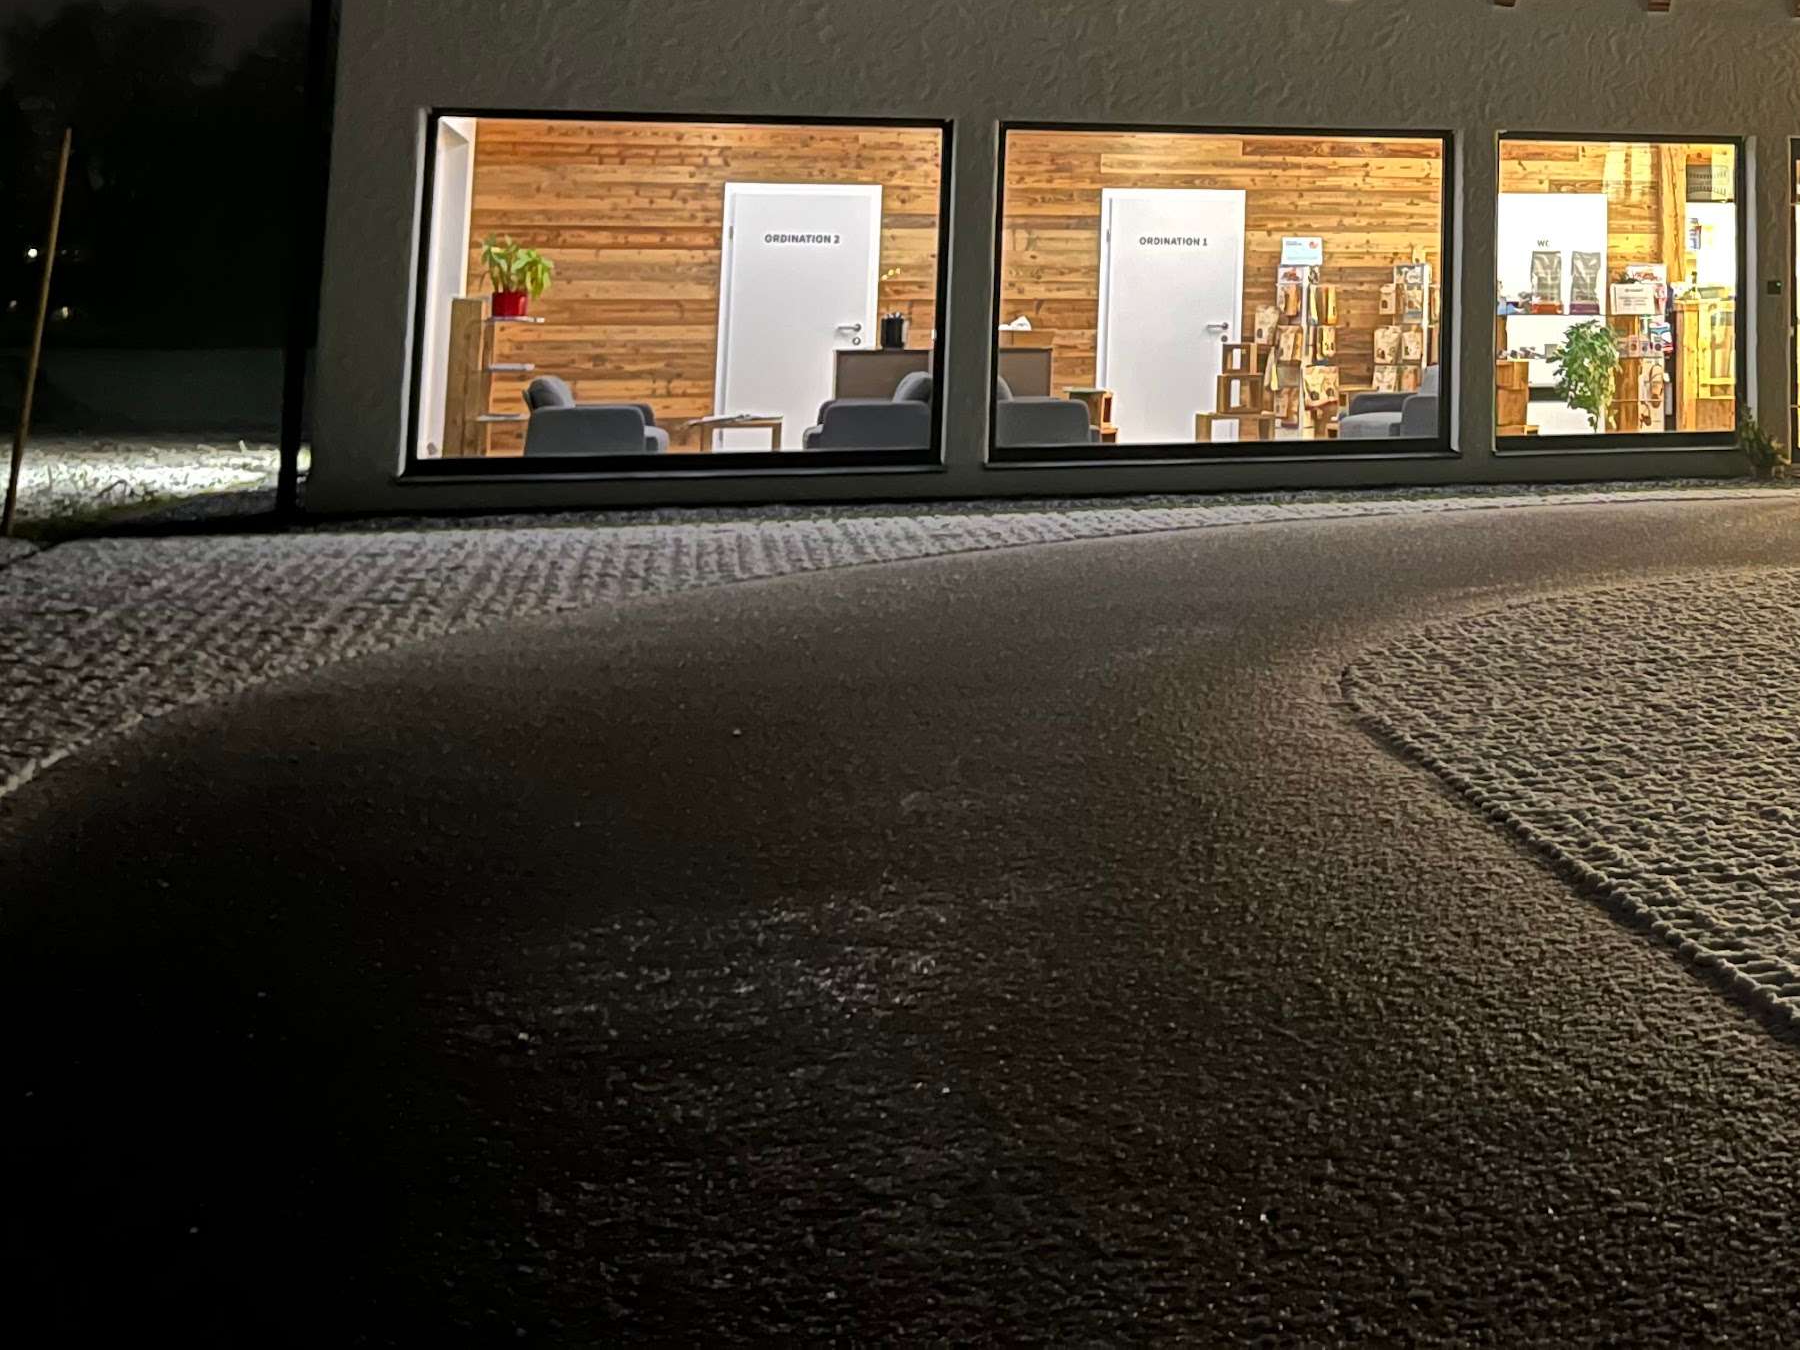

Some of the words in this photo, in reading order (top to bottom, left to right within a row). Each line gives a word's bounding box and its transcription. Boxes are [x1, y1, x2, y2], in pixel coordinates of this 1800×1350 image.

[764, 234, 832, 244] ORDINATION
[833, 235, 840, 244] 2
[1139, 236, 1200, 246] ORDINATION
[1202, 237, 1208, 247] 1
